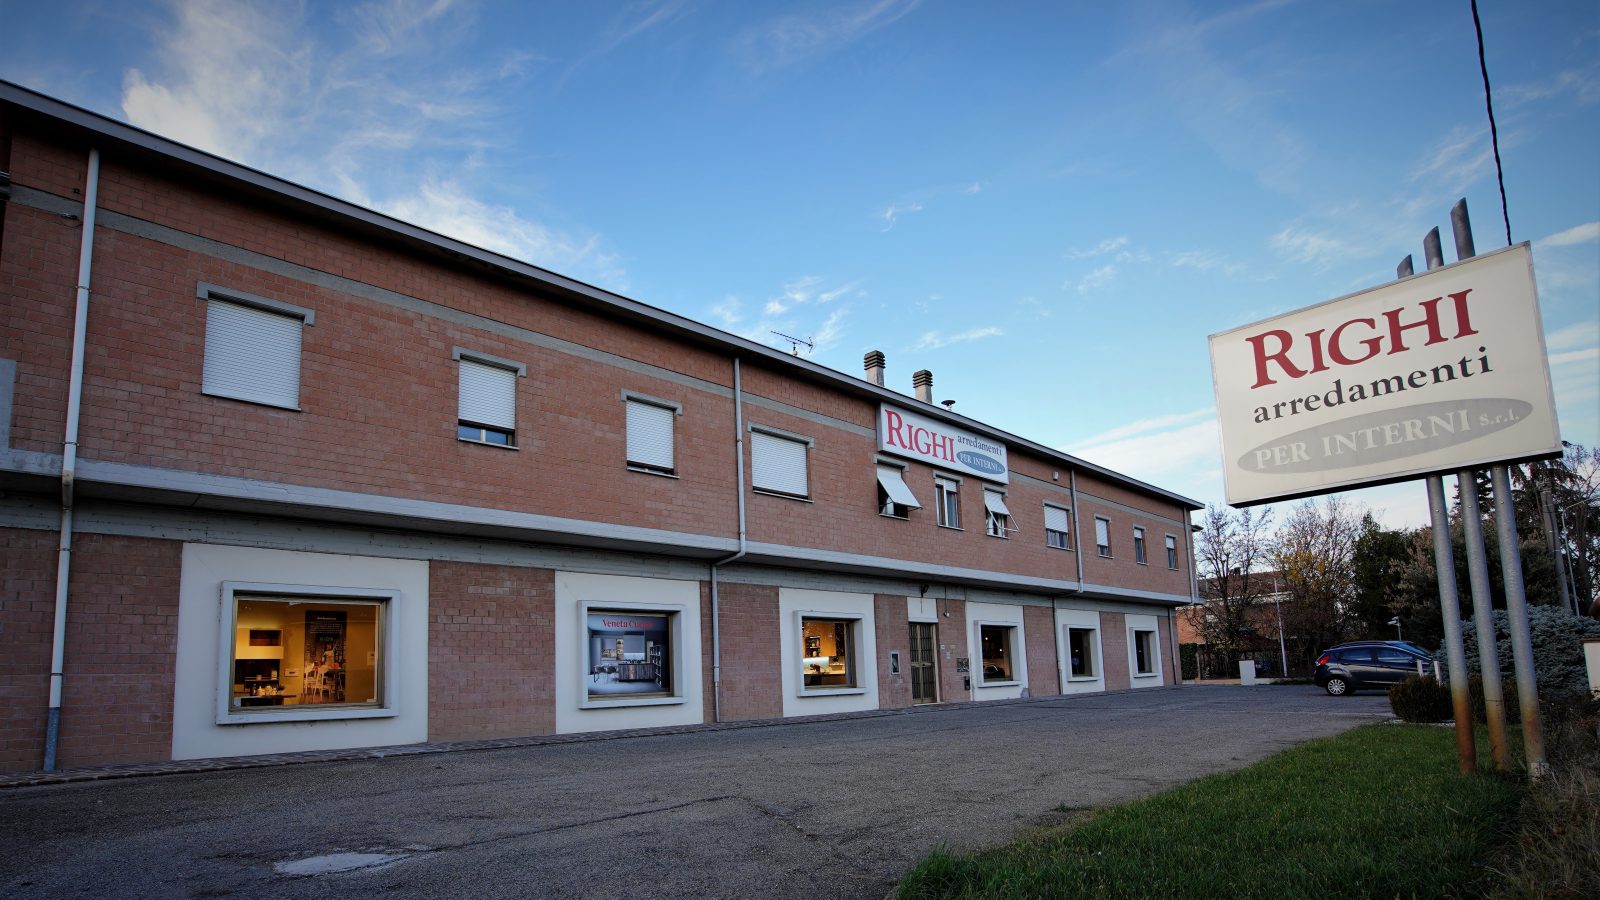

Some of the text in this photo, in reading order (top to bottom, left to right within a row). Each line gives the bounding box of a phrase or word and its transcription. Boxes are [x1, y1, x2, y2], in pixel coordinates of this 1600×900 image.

[1245, 288, 1479, 390] RIGHI
[1253, 346, 1494, 424] arredamenti
[885, 409, 956, 463] RIGHI
[957, 435, 1002, 456] arredamenti
[960, 452, 971, 464] PER
[973, 456, 998, 471] INTERNI
[1254, 442, 1312, 470] PER
[1322, 408, 1473, 457] INTERNI
[602, 619, 628, 628] Veneta
